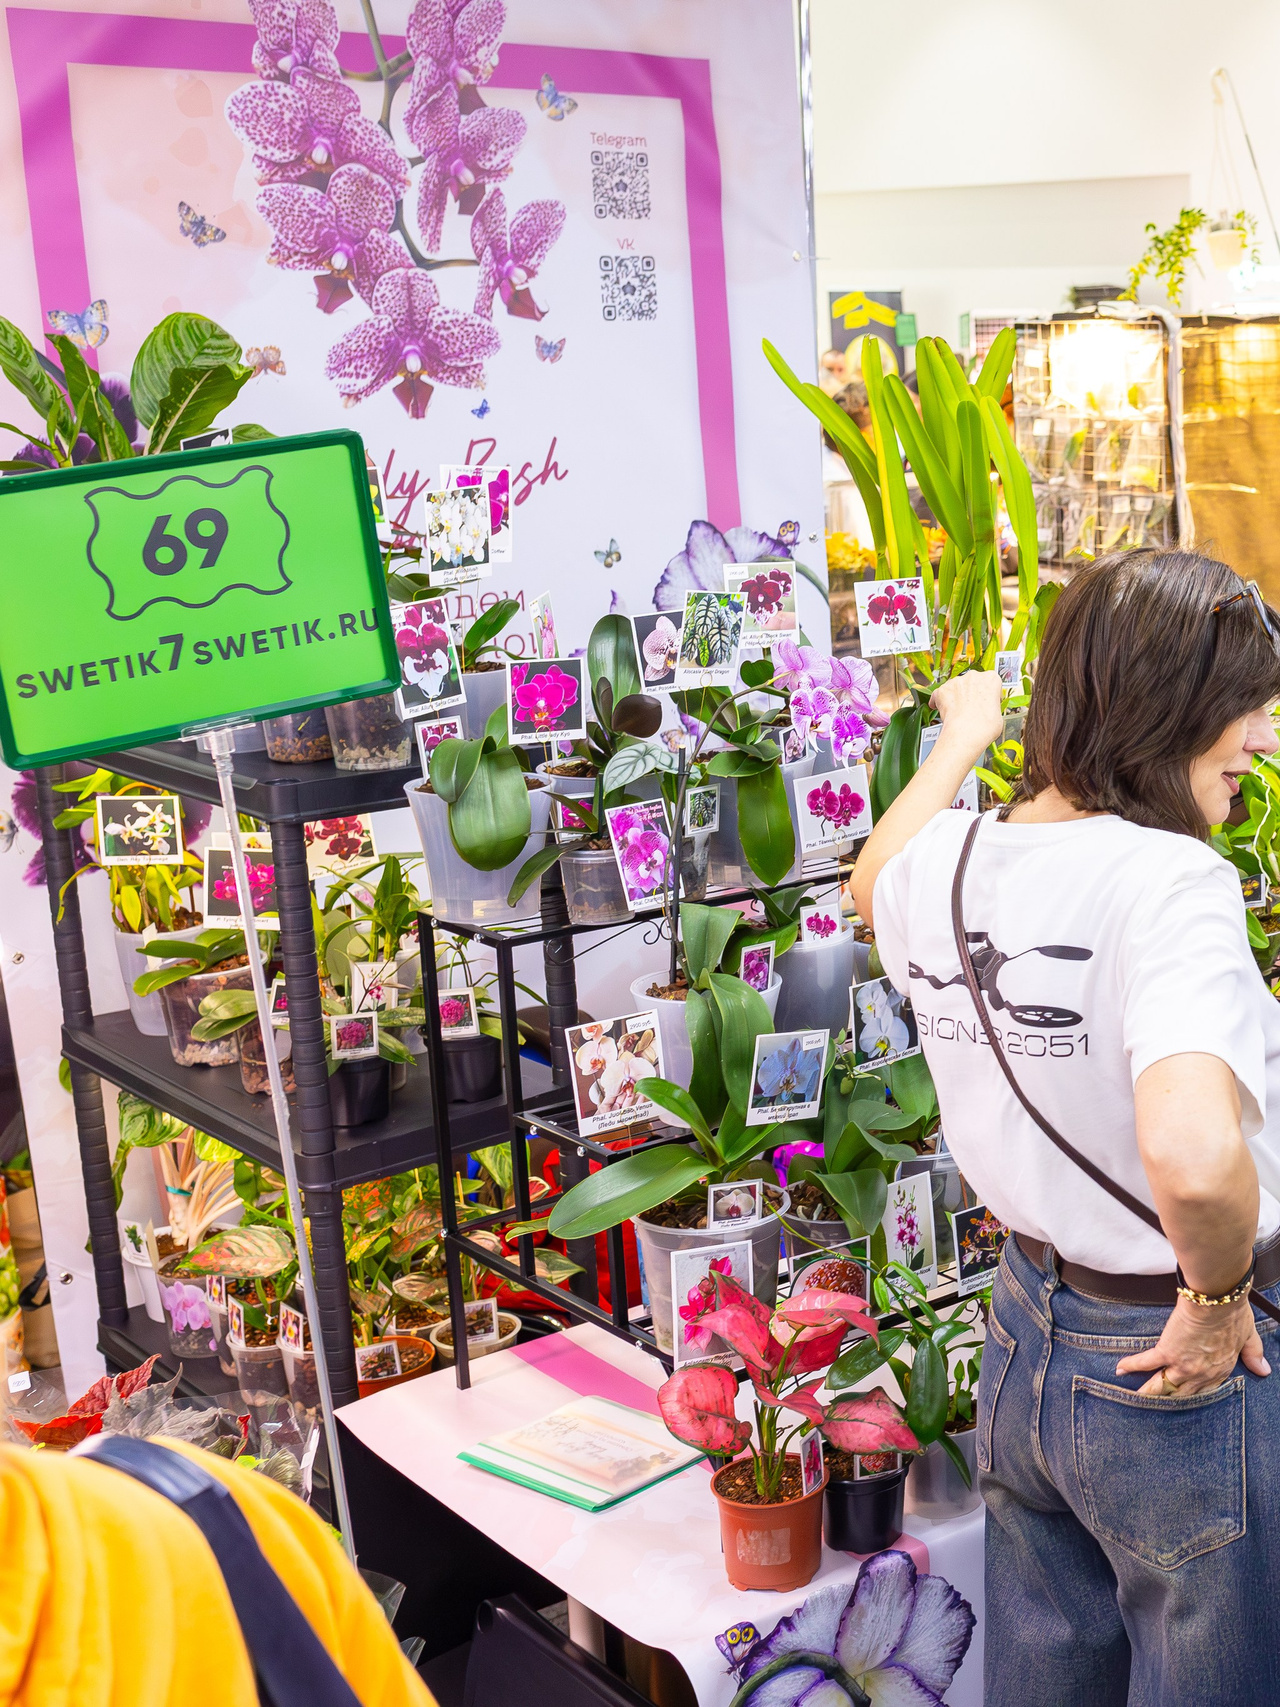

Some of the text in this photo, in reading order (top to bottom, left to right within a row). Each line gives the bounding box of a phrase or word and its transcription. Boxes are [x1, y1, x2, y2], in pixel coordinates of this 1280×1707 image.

[590, 132, 647, 149] Telegram
[616, 238, 635, 250] VK
[142, 507, 229, 576] 69
[15, 607, 380, 699] SWETIK7SWETIK.RU
[592, 1114, 607, 1123] Phal.
[635, 1103, 653, 1112] Venus
[757, 1107, 769, 1115] Phal.
[598, 1120, 616, 1130] (Леди
